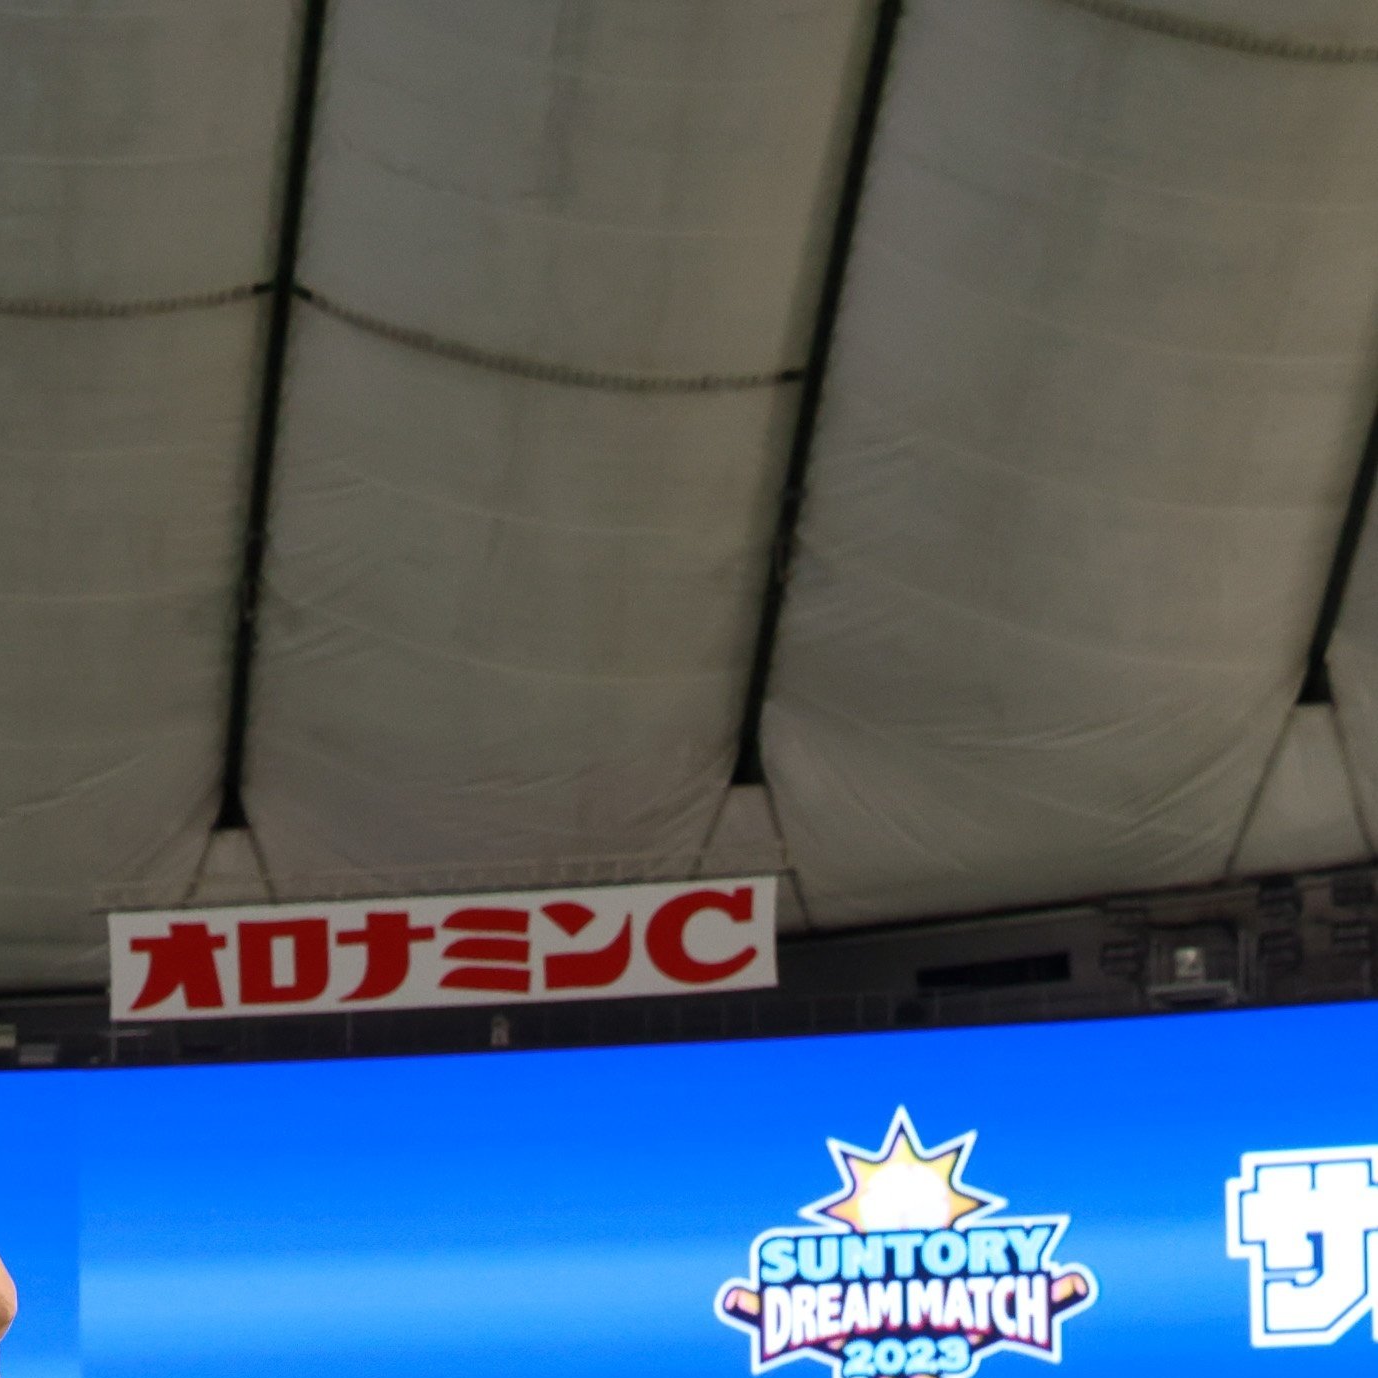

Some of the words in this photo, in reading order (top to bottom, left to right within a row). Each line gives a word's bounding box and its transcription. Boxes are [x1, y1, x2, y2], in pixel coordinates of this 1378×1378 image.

[129, 886, 758, 1012] オロナミンC
[758, 1224, 1054, 1283] SUNTORY
[762, 1280, 903, 1356] DREAM
[906, 1273, 1050, 1344] MATCH
[845, 1336, 971, 1377] 2023
